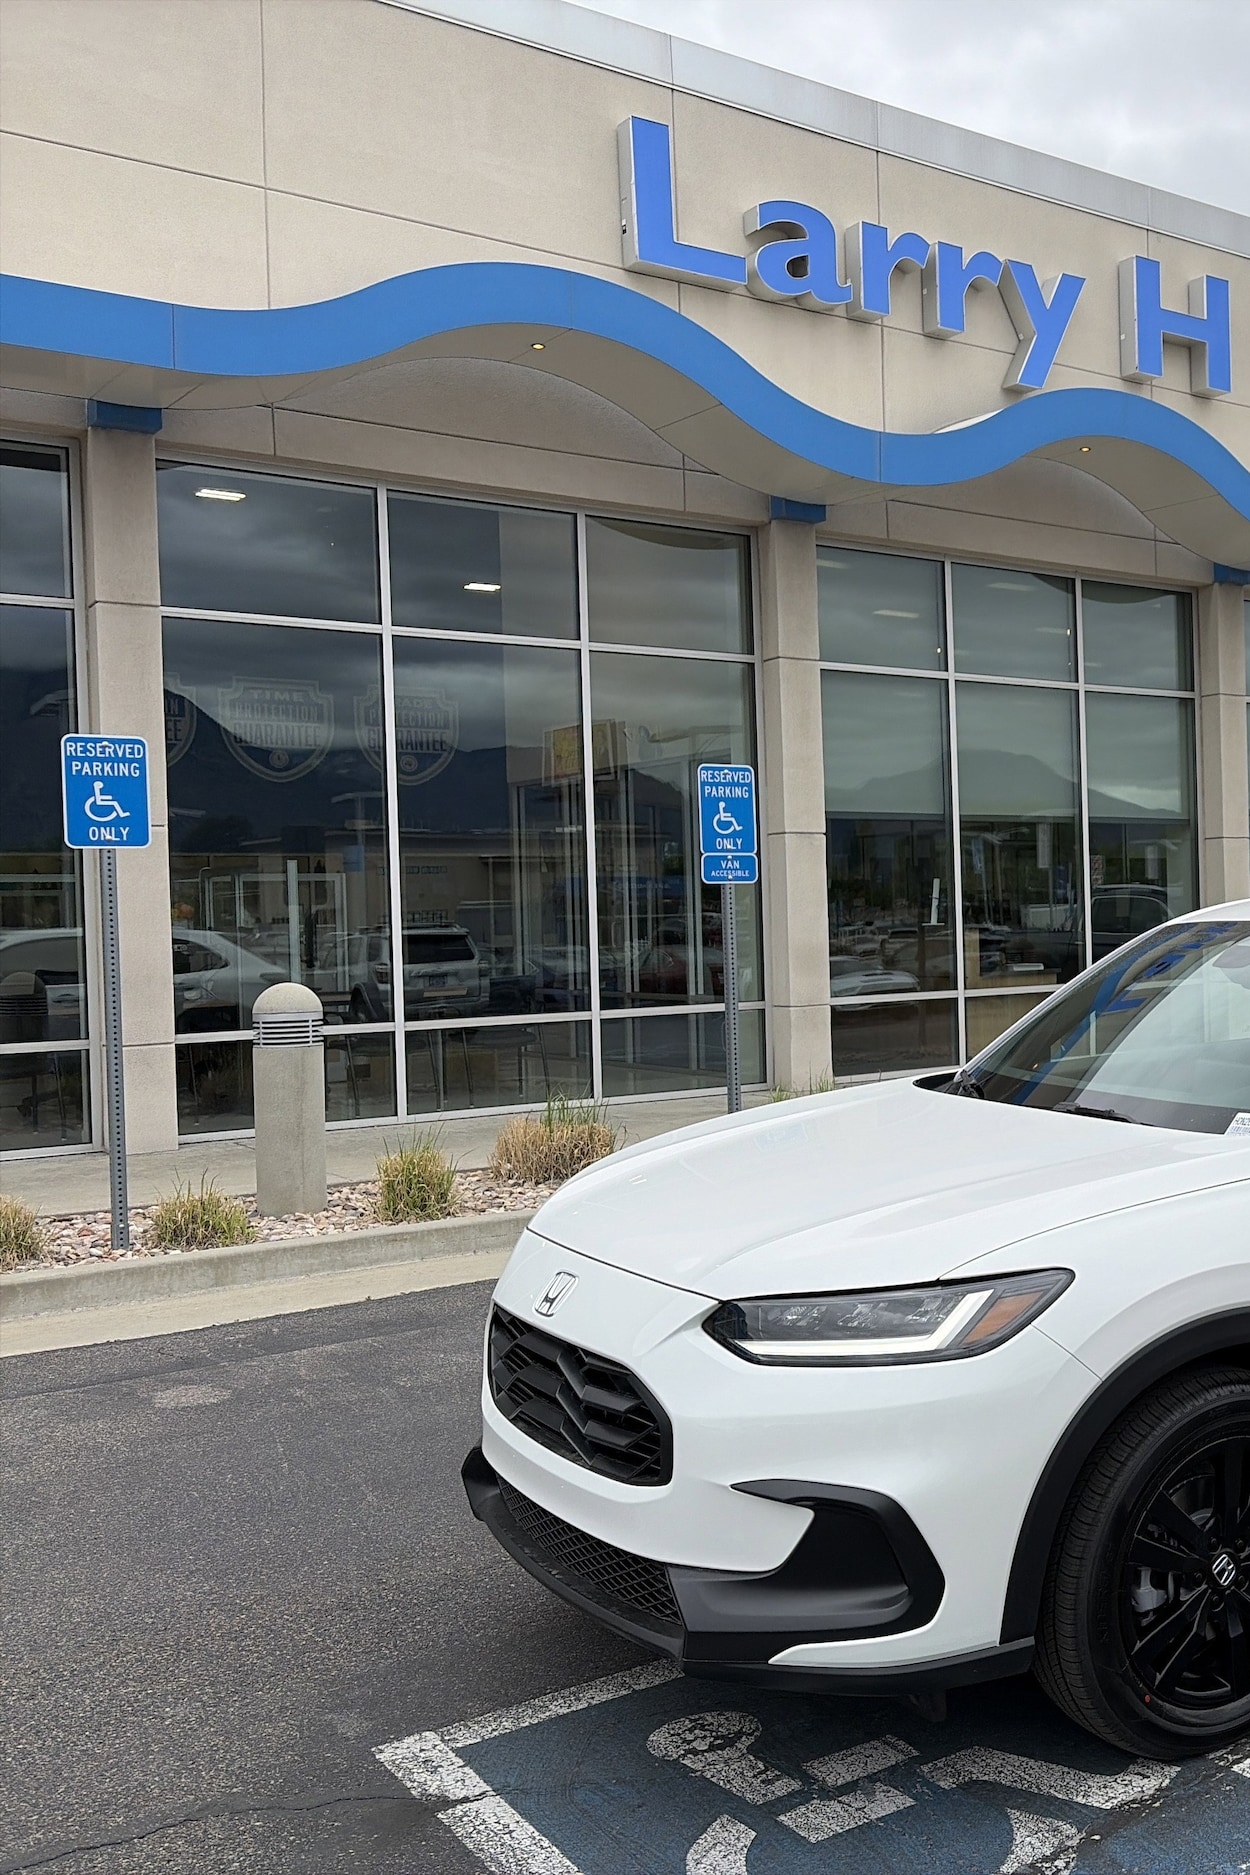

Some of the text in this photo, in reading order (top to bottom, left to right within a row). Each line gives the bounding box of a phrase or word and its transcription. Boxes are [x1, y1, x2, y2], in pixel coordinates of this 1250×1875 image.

[618, 115, 1086, 392] Larry
[1119, 255, 1231, 397] H
[249, 689, 304, 702] TIME
[235, 702, 318, 721] PROTECTION
[233, 722, 322, 748] GUARANTEE
[66, 741, 144, 758] RESERVED
[71, 761, 140, 777] PARKING
[700, 770, 751, 783] RESERVED
[704, 785, 749, 798] PARKING
[89, 826, 130, 841] ONLY
[716, 838, 743, 850] ONLY
[720, 859, 740, 869] VAN
